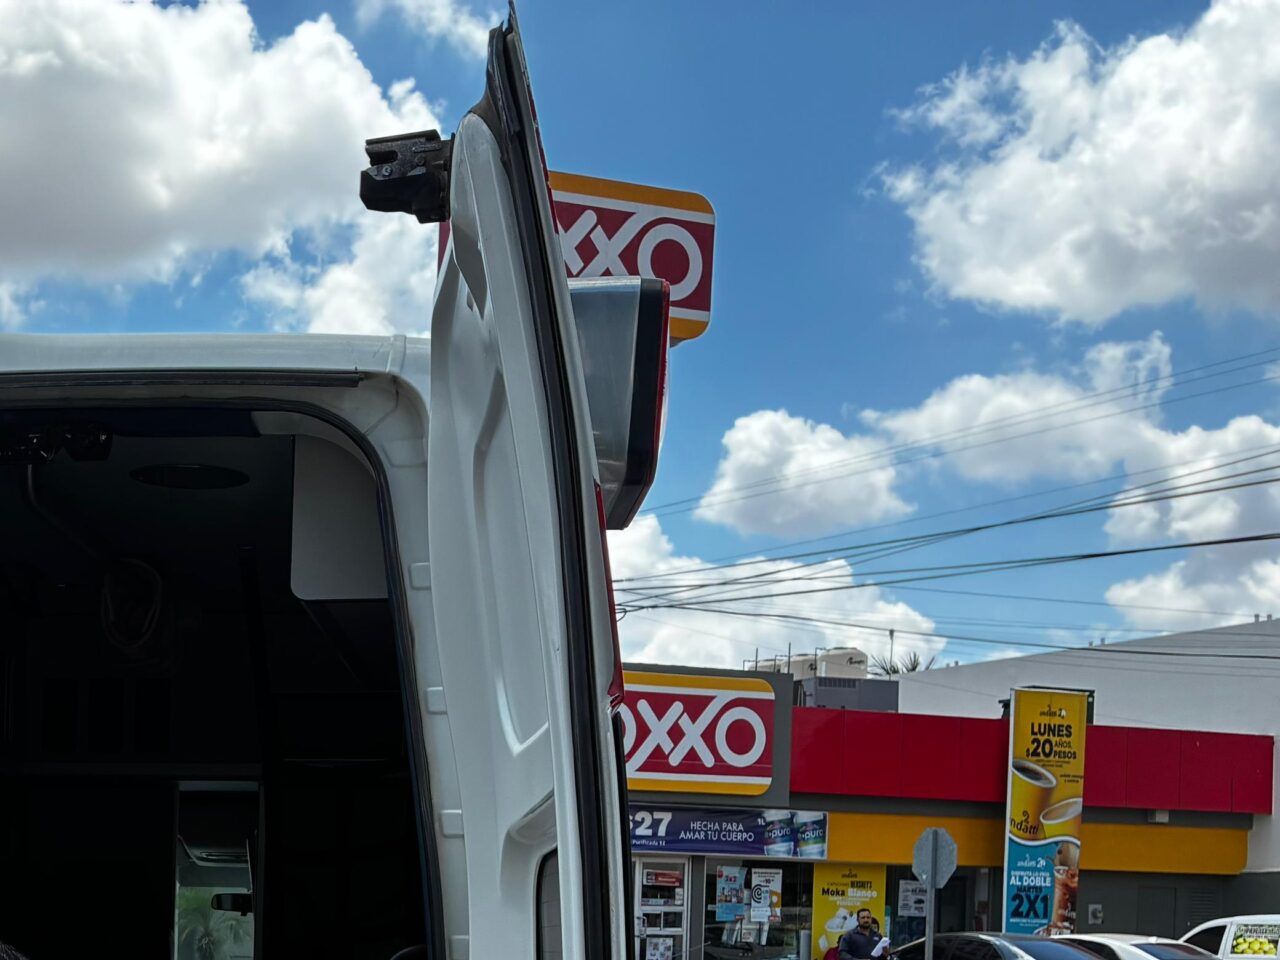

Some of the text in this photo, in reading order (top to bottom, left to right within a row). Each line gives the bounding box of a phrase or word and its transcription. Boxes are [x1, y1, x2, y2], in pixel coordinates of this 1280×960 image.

[1030, 722, 1073, 738] LUNES
[1053, 750, 1077, 760] PESOS
[690, 821, 744, 831] HECHA PARA
[679, 830, 754, 842] AMAR TU CUERPO
[1009, 876, 1052, 887] AL DOBLE
[821, 888, 878, 898] Moka Blanco
[1010, 893, 1049, 919] 2X1
